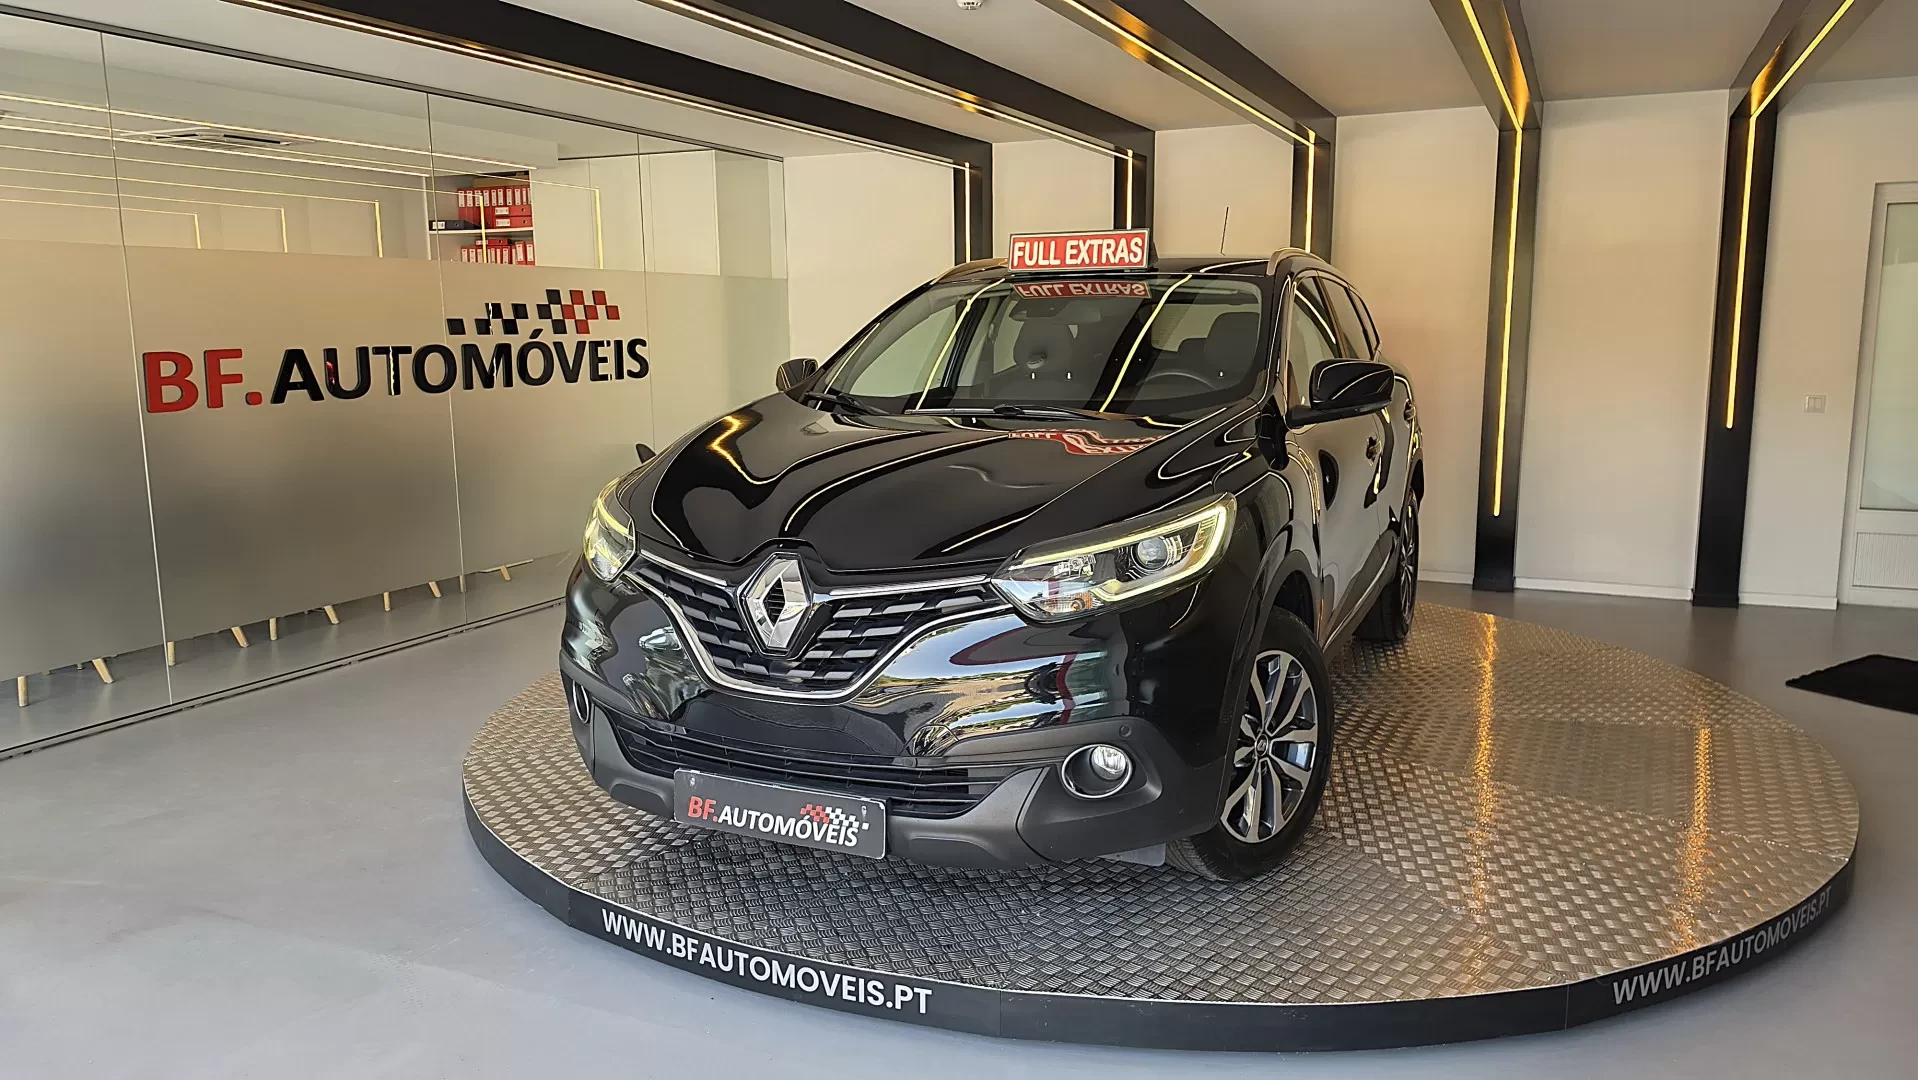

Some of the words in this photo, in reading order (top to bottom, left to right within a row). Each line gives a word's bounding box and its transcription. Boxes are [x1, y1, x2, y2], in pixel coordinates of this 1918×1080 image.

[1013, 240, 1061, 267] FULL
[1065, 237, 1143, 265] EXTRAS
[602, 908, 932, 1014] WWW.BFAUTOMOVEIS.PT
[1613, 885, 1832, 1005] WWW.BFAUTOMOVEIS.PT
